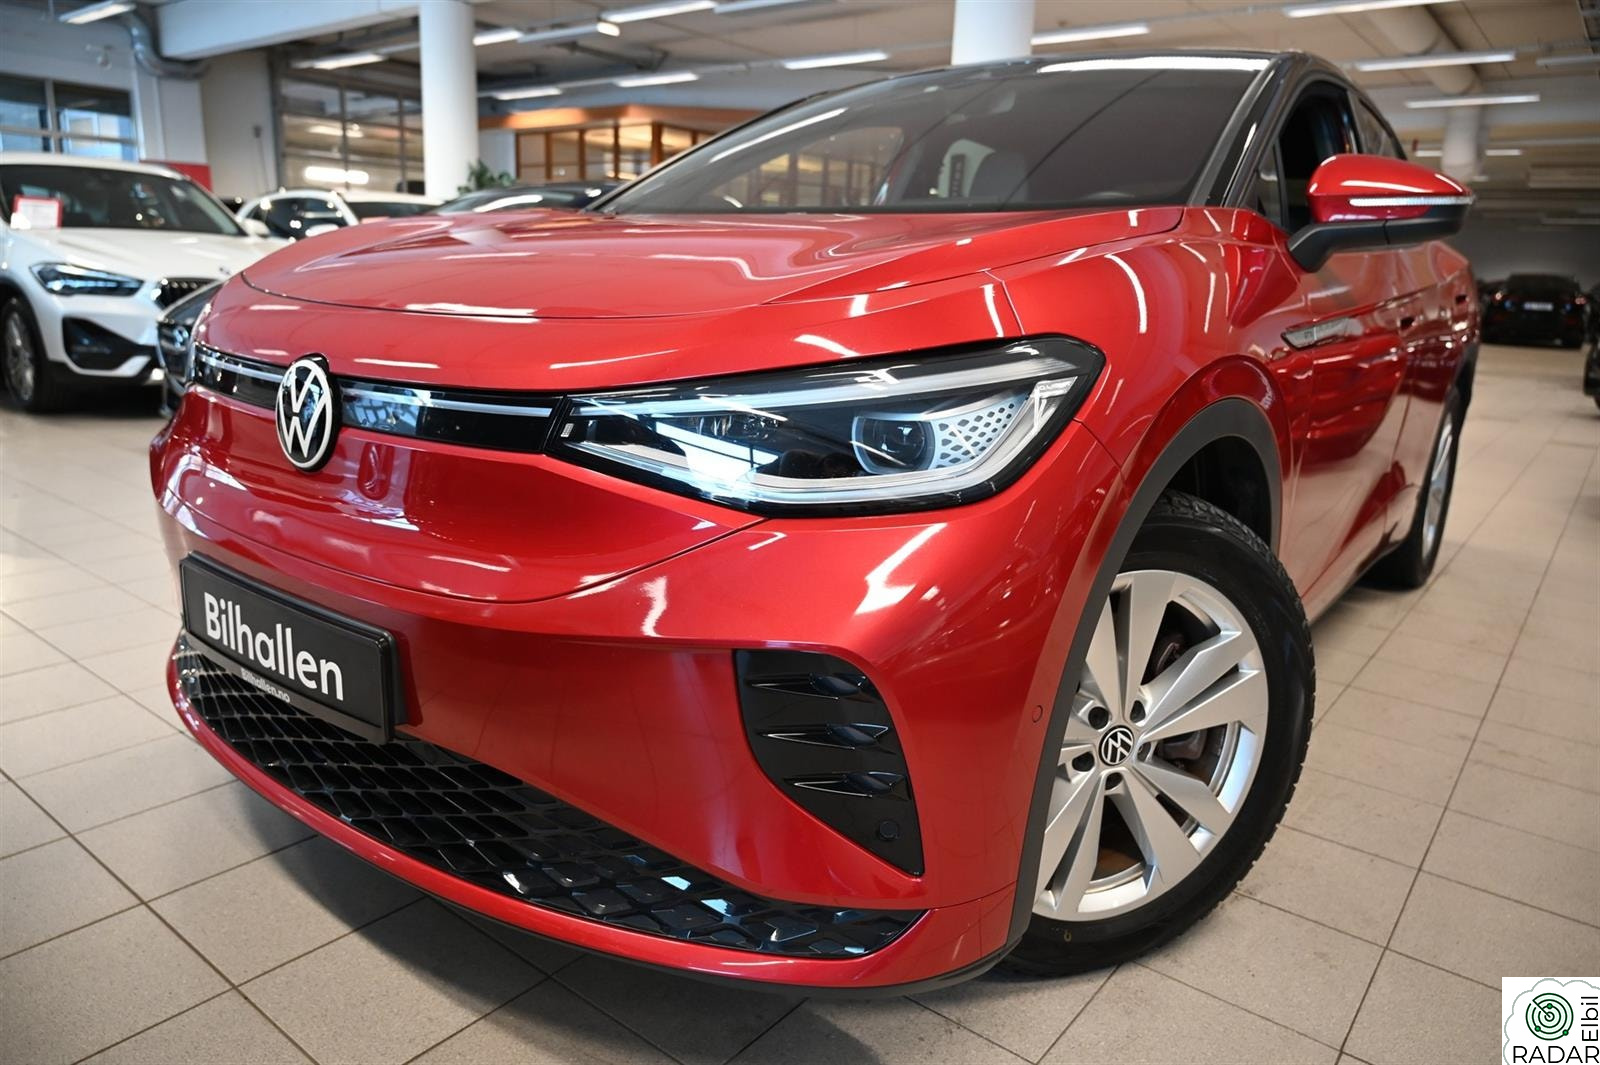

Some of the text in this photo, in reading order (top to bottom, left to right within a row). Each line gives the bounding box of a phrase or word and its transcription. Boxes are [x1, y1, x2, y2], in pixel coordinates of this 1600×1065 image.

[275, 359, 333, 469] VW
[203, 591, 344, 701] Bilhallen
[1101, 727, 1134, 765] VW
